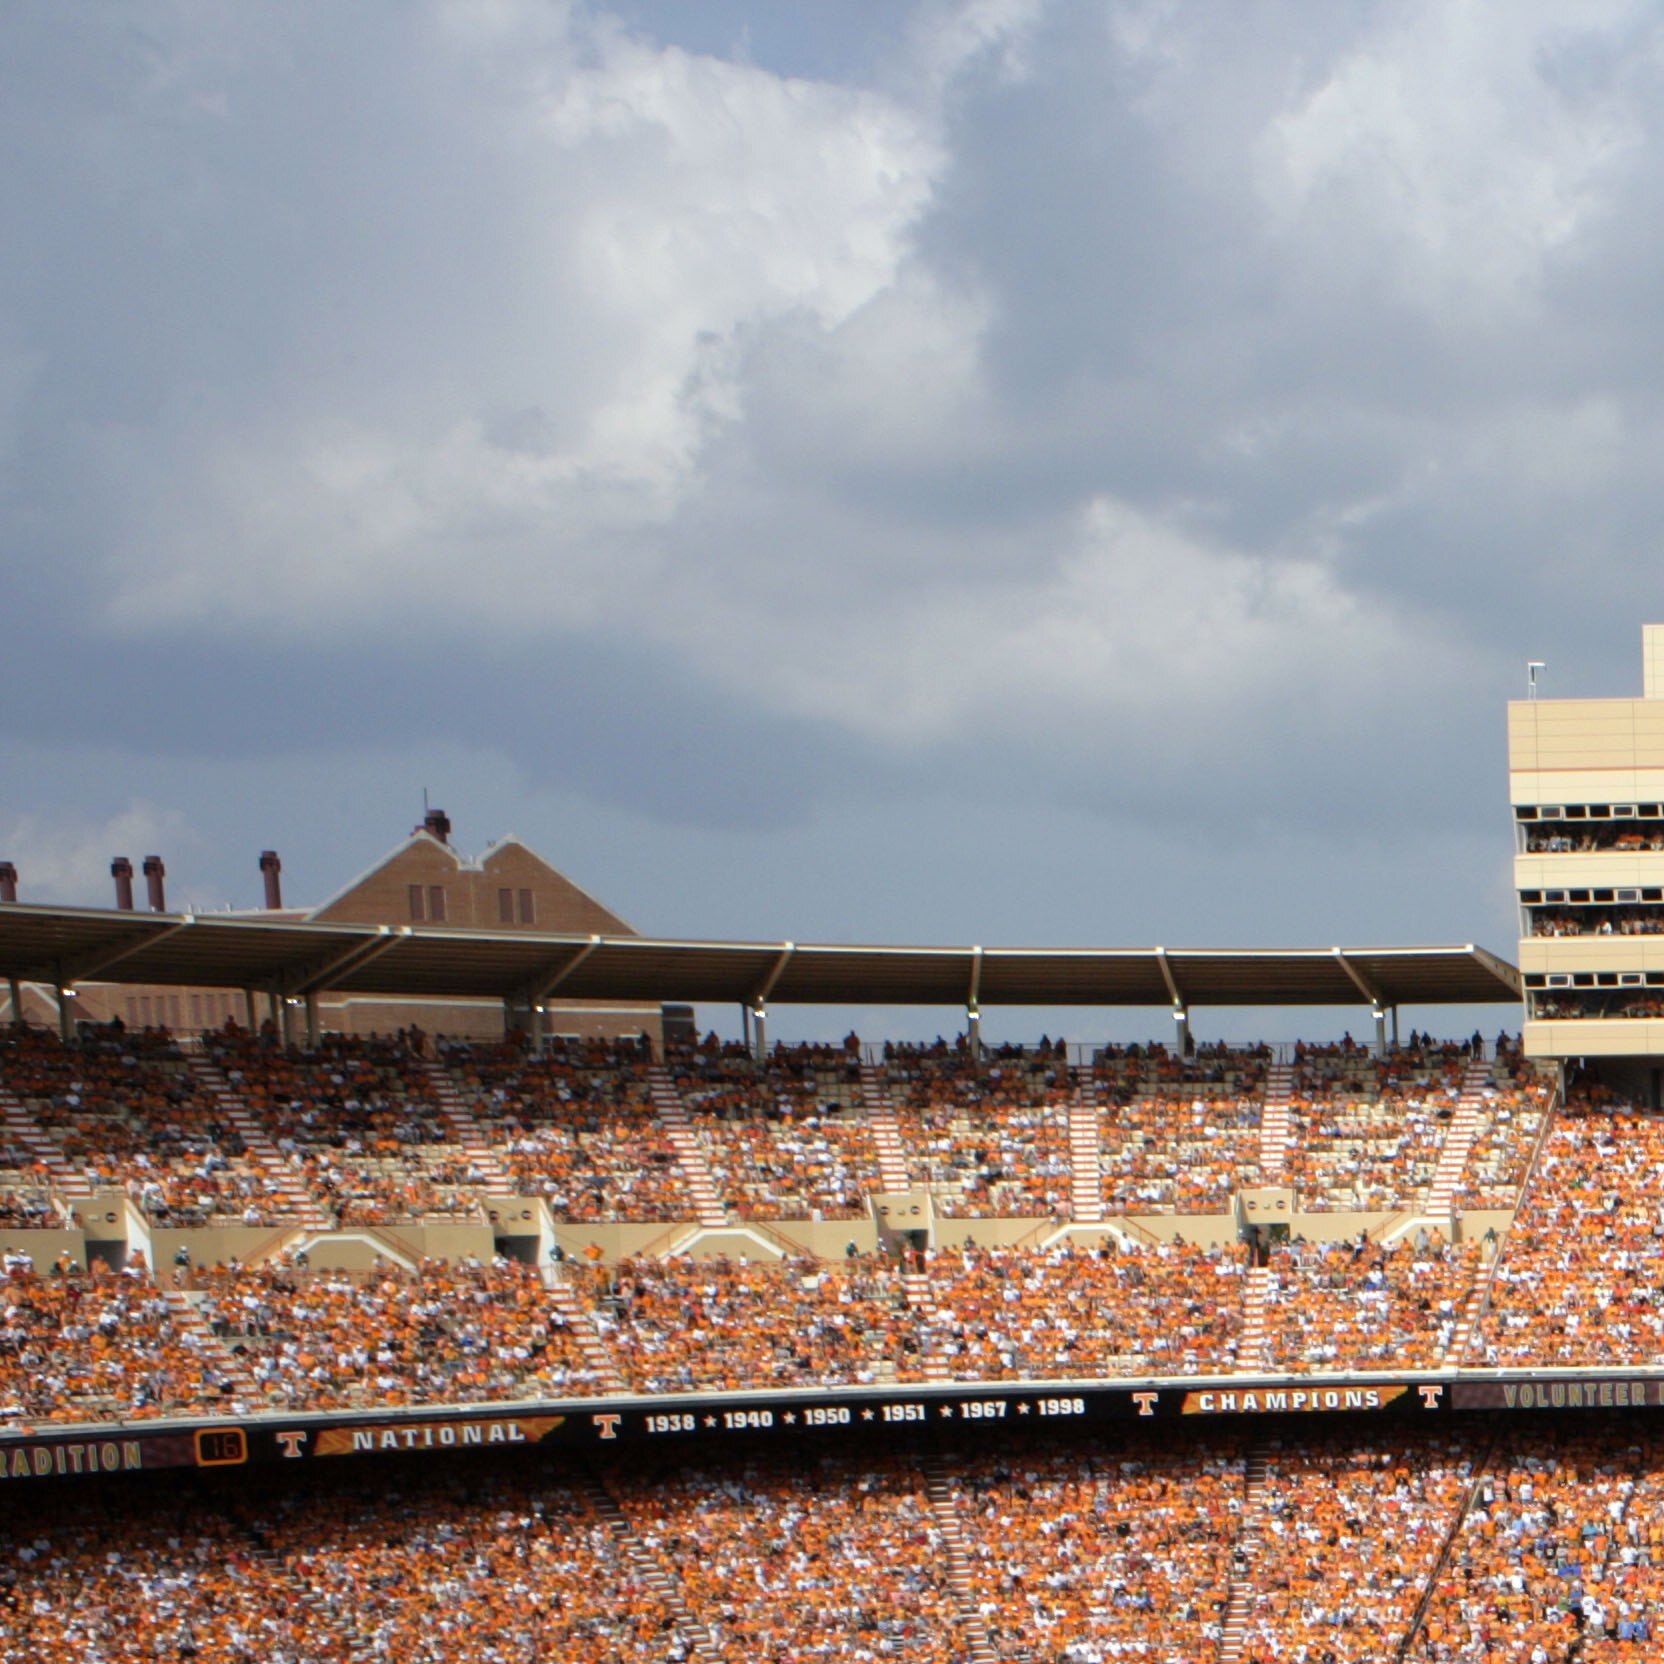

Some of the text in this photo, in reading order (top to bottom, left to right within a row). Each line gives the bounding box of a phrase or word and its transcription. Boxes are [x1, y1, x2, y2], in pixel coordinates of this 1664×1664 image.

[1133, 1392, 1159, 1417] T
[1199, 1389, 1379, 1411] CHAMPIONS
[1419, 1385, 1443, 1409] T
[1503, 1381, 1645, 1408] VOLUNTEER
[593, 1414, 621, 1439] T
[646, 1398, 1085, 1433] 1938 1940 1950 1951 1967 1998
[276, 1431, 307, 1458] T
[352, 1422, 525, 1451] NATIONAL
